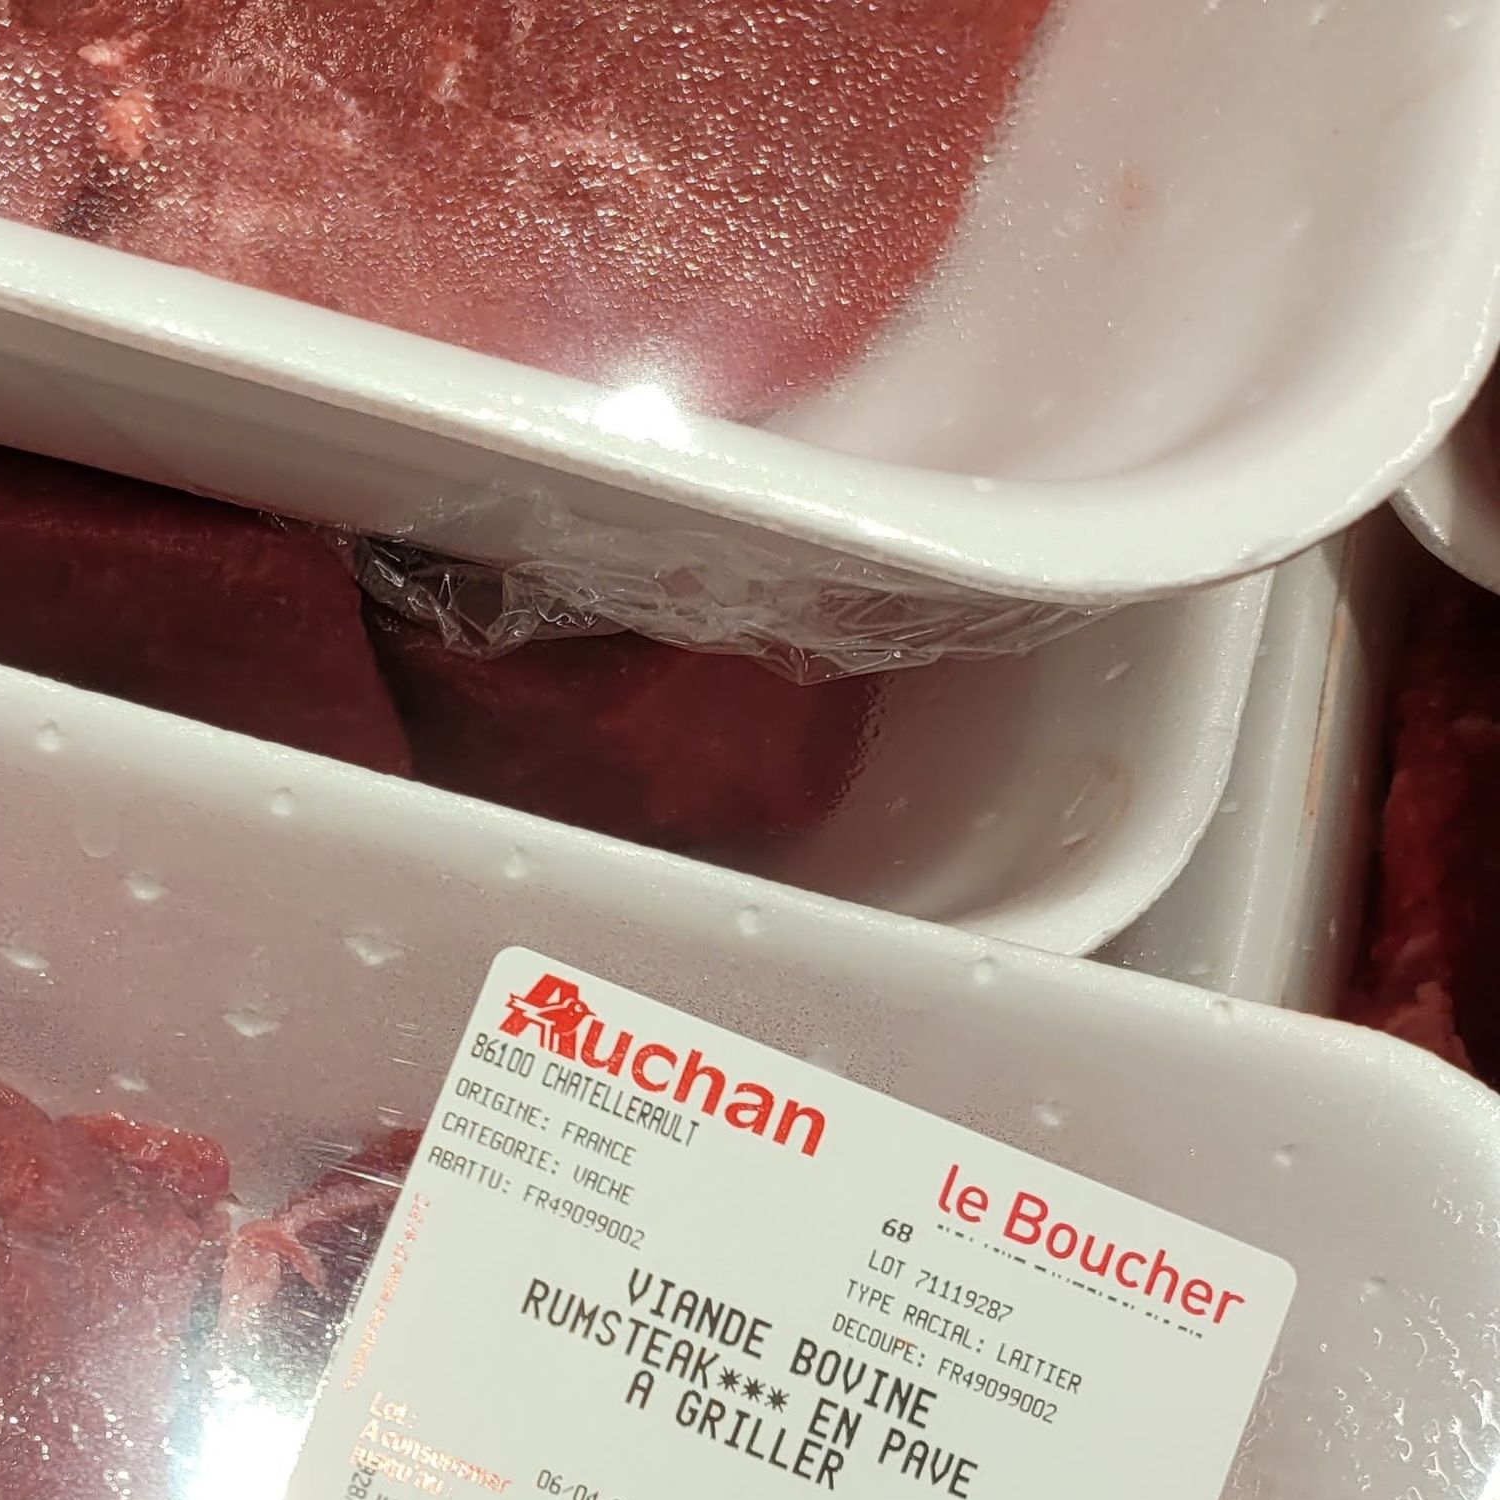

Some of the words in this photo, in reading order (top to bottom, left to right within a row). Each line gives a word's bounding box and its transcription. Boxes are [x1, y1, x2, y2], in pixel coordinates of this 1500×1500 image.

[470, 1033, 535, 1078] 86100
[542, 1062, 700, 1147] CHATELLERAULT
[499, 973, 826, 1157] Auchan
[441, 1111, 560, 1175] CATEGORIE:
[573, 1165, 635, 1205] VACHE
[455, 1077, 549, 1131] ORIGINE:
[561, 1121, 637, 1167] FRANCE
[427, 1146, 512, 1194] ABATTU:
[522, 1184, 645, 1251] FR49099002
[937, 1164, 989, 1224] le
[1002, 1191, 1246, 1324] Boucher
[846, 1279, 896, 1315] TYPE
[902, 1304, 985, 1354] RACIAL:
[995, 1342, 1083, 1395] LAITIER
[868, 1249, 906, 1279] LOT
[915, 1269, 1013, 1322] 71119287
[627, 1267, 772, 1359] VIANDE
[789, 1338, 938, 1430] BOVINE
[832, 1313, 926, 1367] DECOUPE:
[936, 1358, 1058, 1424] FR49099002
[625, 1370, 656, 1410] A
[675, 1389, 844, 1490] GRILLER
[808, 1397, 864, 1450] EN
[878, 1428, 979, 1500] PAVE
